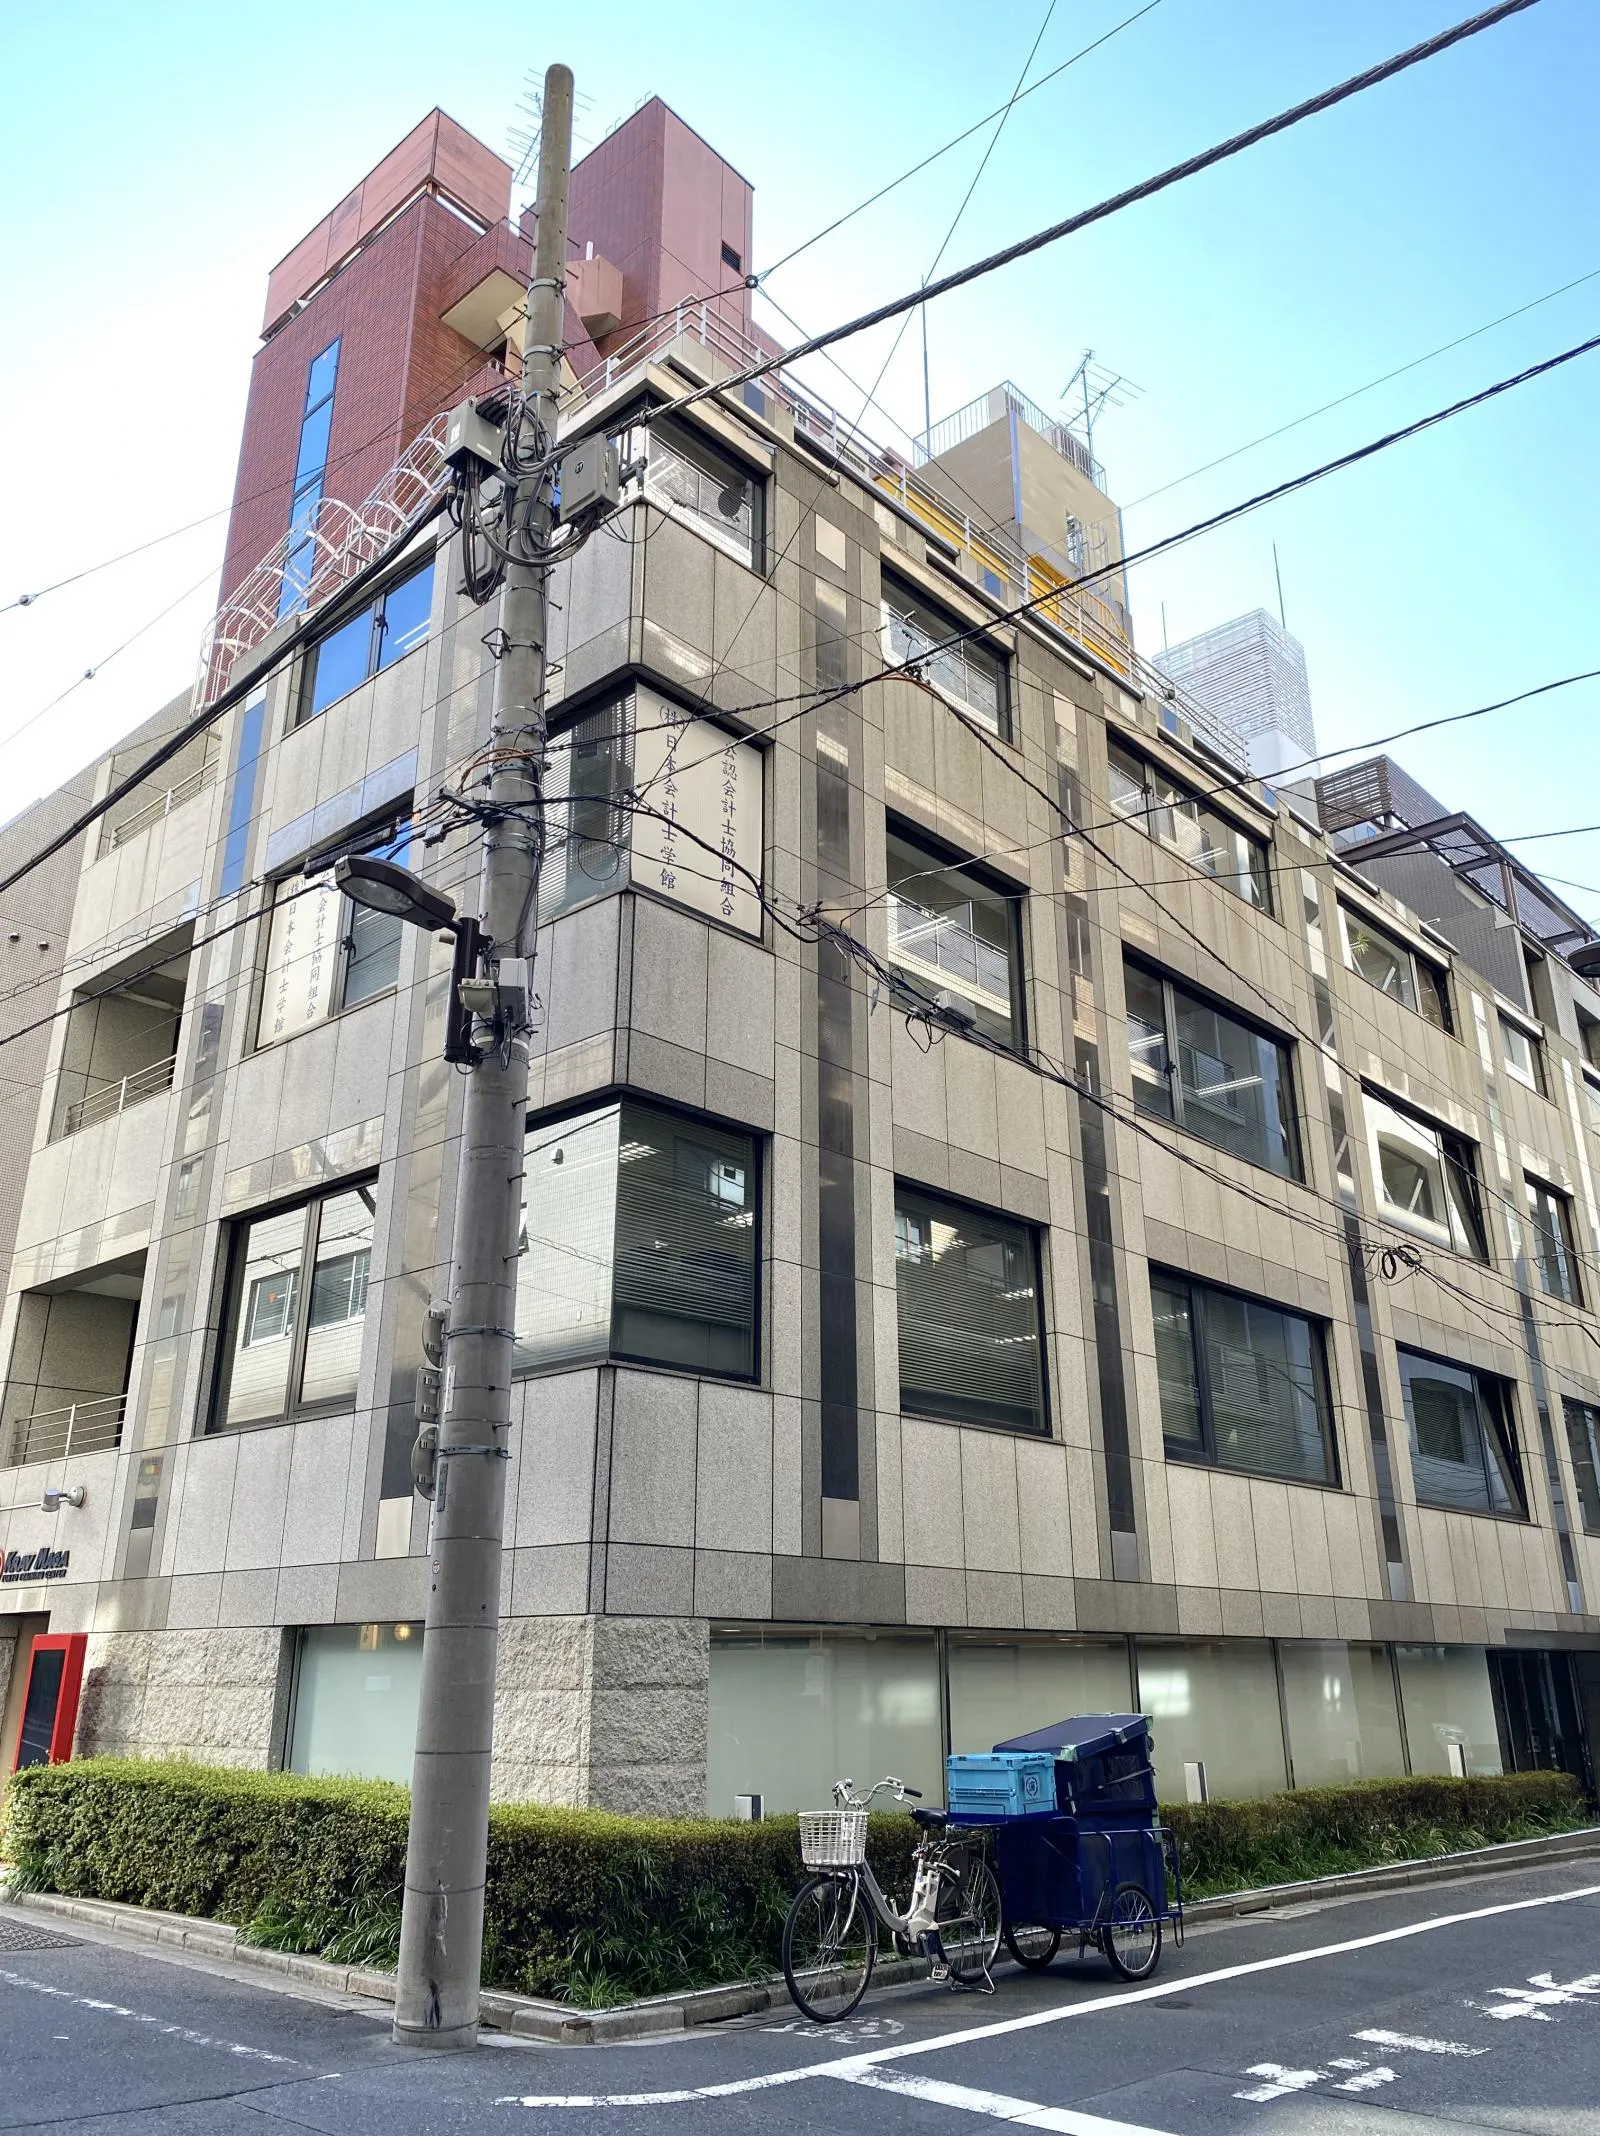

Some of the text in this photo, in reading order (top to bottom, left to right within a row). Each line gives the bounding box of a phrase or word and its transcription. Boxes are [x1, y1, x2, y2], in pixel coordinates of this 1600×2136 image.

[720, 741, 738, 917] 公認会計士協同組合
